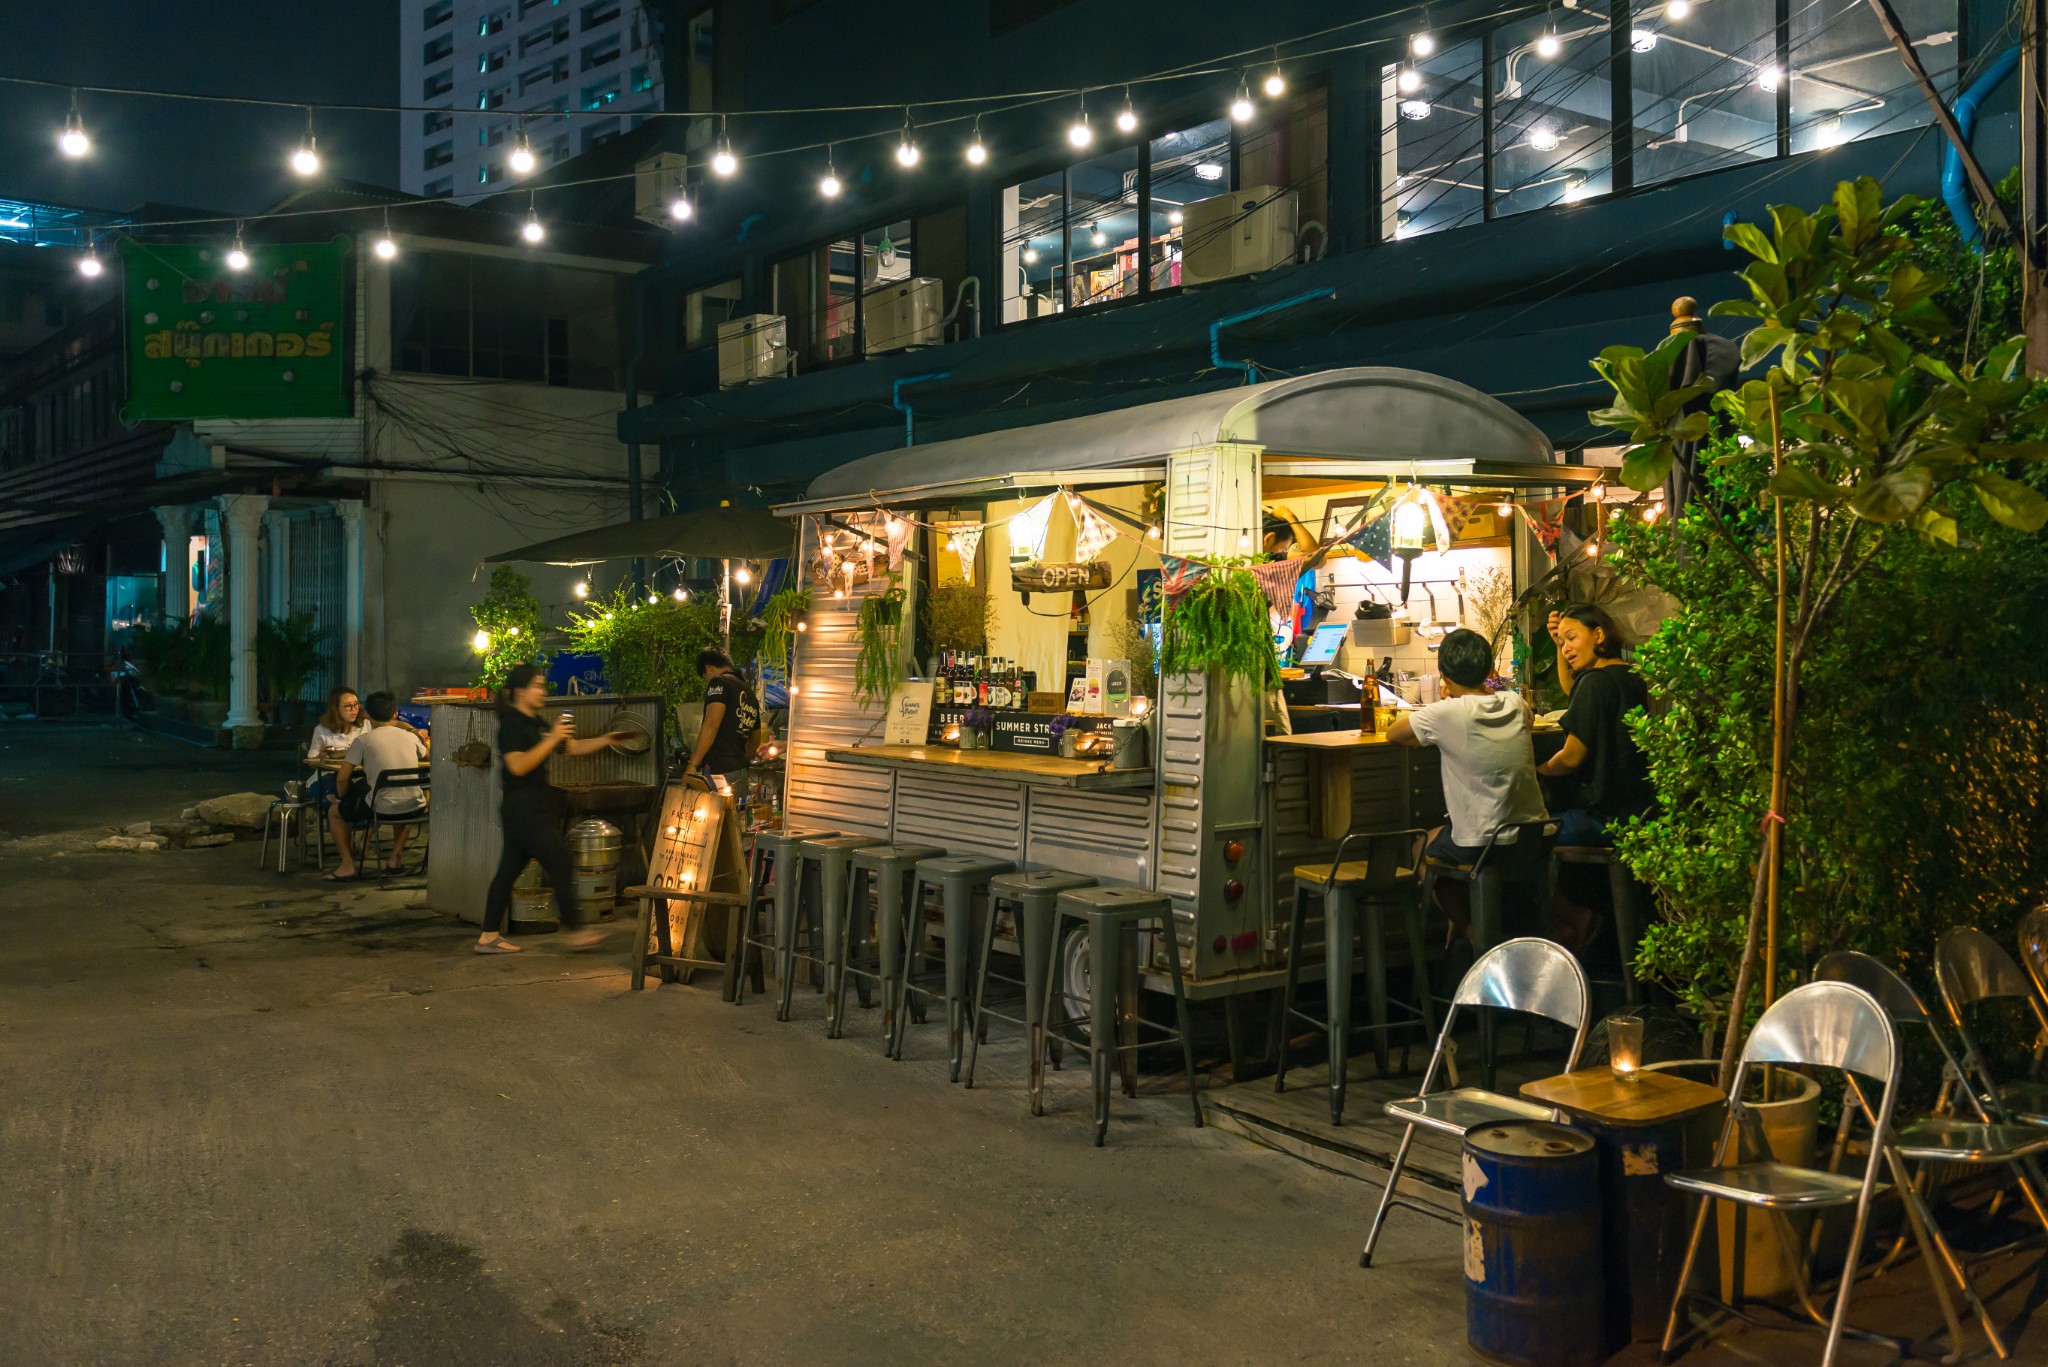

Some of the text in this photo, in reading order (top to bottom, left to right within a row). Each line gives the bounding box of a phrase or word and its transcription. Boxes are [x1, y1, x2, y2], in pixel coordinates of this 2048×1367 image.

[1042, 567, 1090, 588] OPEN
[940, 713, 965, 724] BEER
[995, 721, 1030, 733] SUMMER
